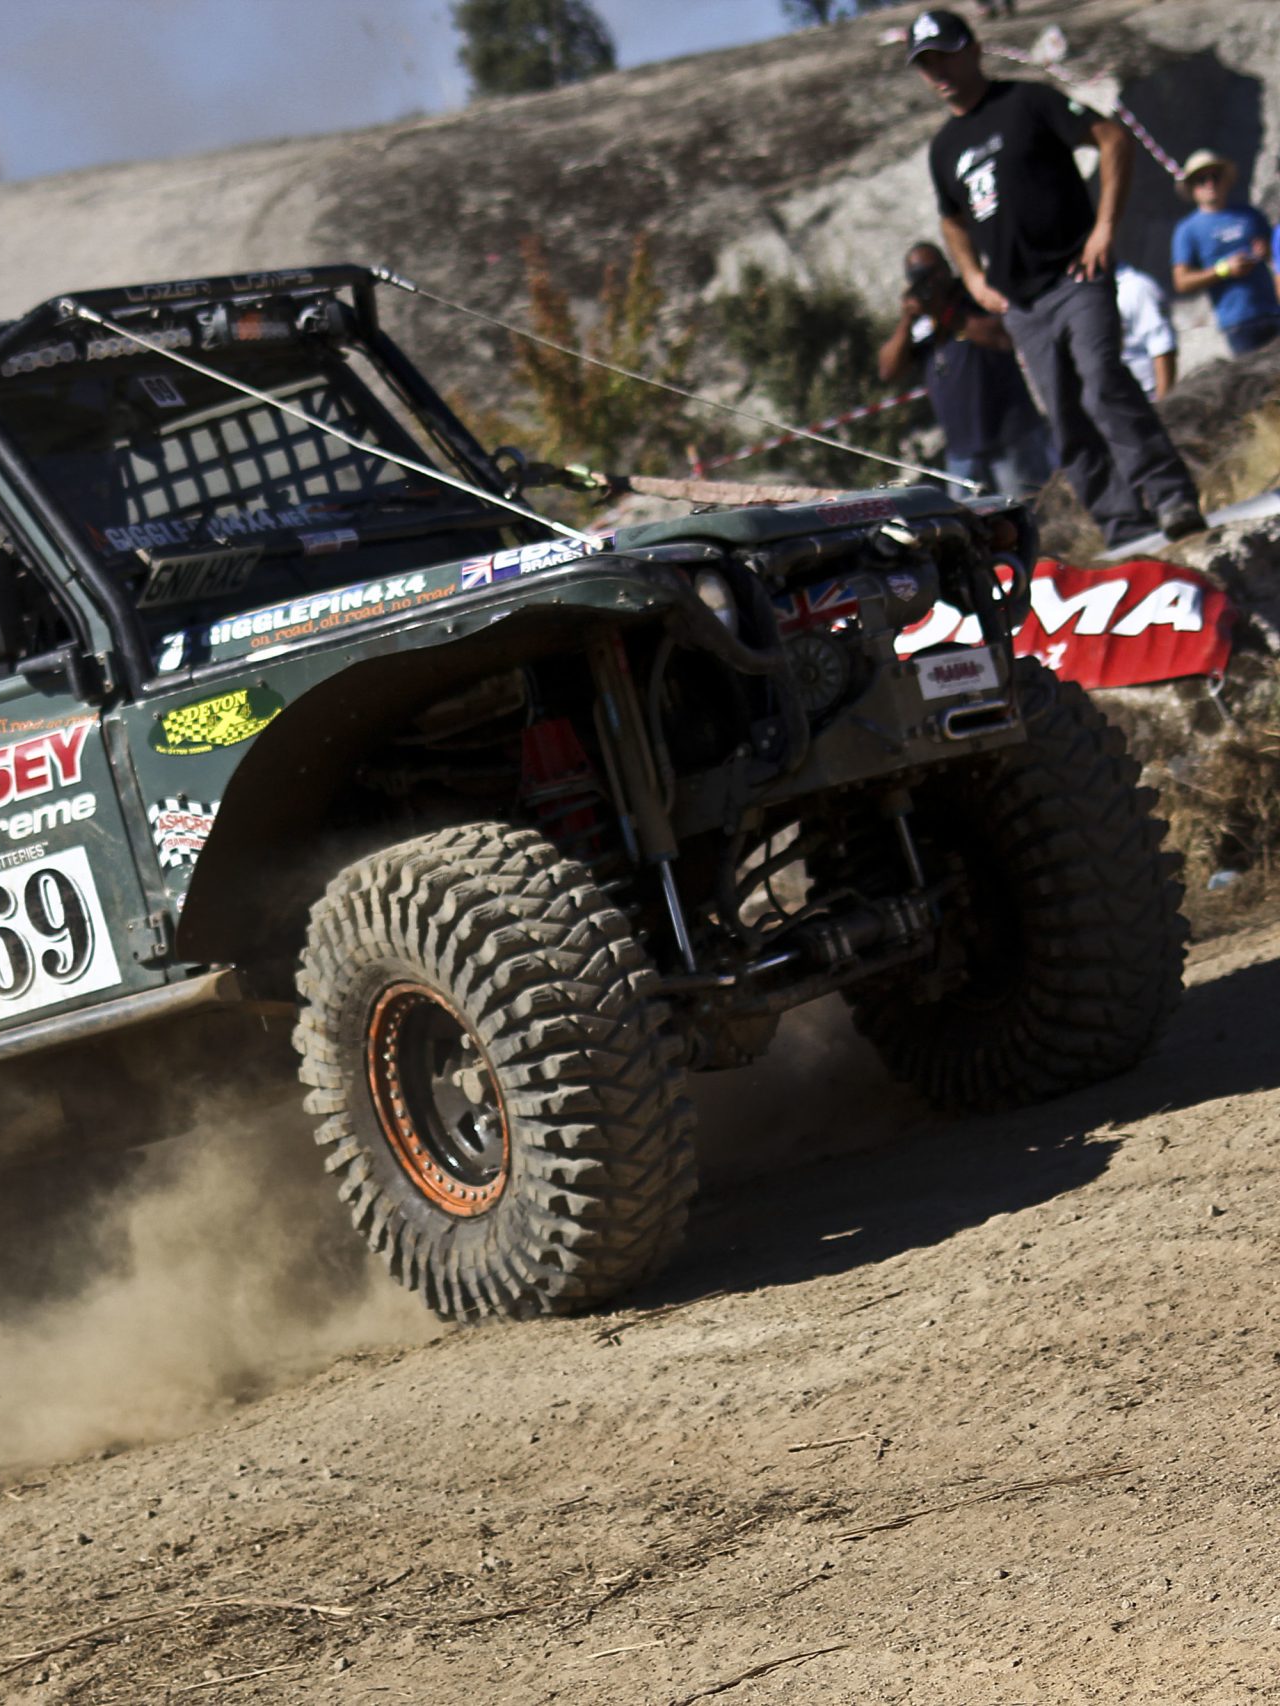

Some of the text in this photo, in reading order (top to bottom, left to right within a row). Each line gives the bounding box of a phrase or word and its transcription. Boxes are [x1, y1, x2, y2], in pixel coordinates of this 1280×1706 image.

[521, 548, 584, 574] BRAKES
[251, 634, 270, 648] on
[182, 689, 248, 721] DEVON
